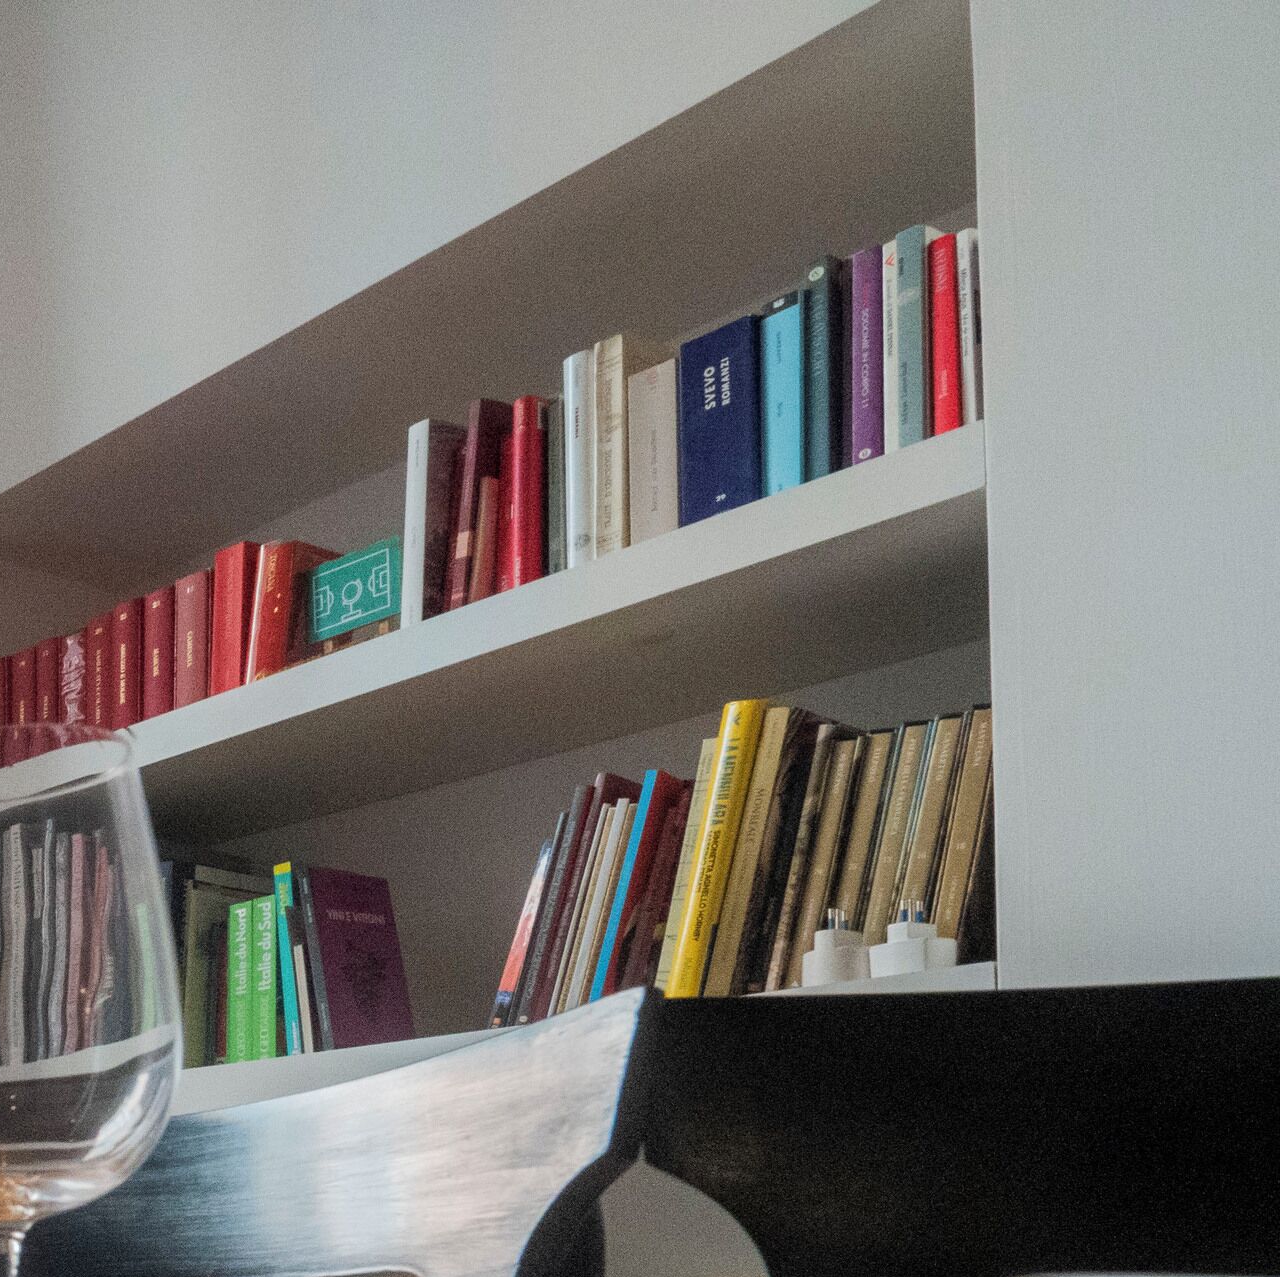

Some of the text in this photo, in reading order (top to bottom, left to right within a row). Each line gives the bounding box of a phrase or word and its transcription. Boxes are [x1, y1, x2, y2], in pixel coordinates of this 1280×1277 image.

[703, 366, 717, 411] SVEVO
[719, 356, 731, 407] ROMANZI
[234, 907, 248, 995] Italie du Nord
[257, 901, 273, 991] Italie du Sud
